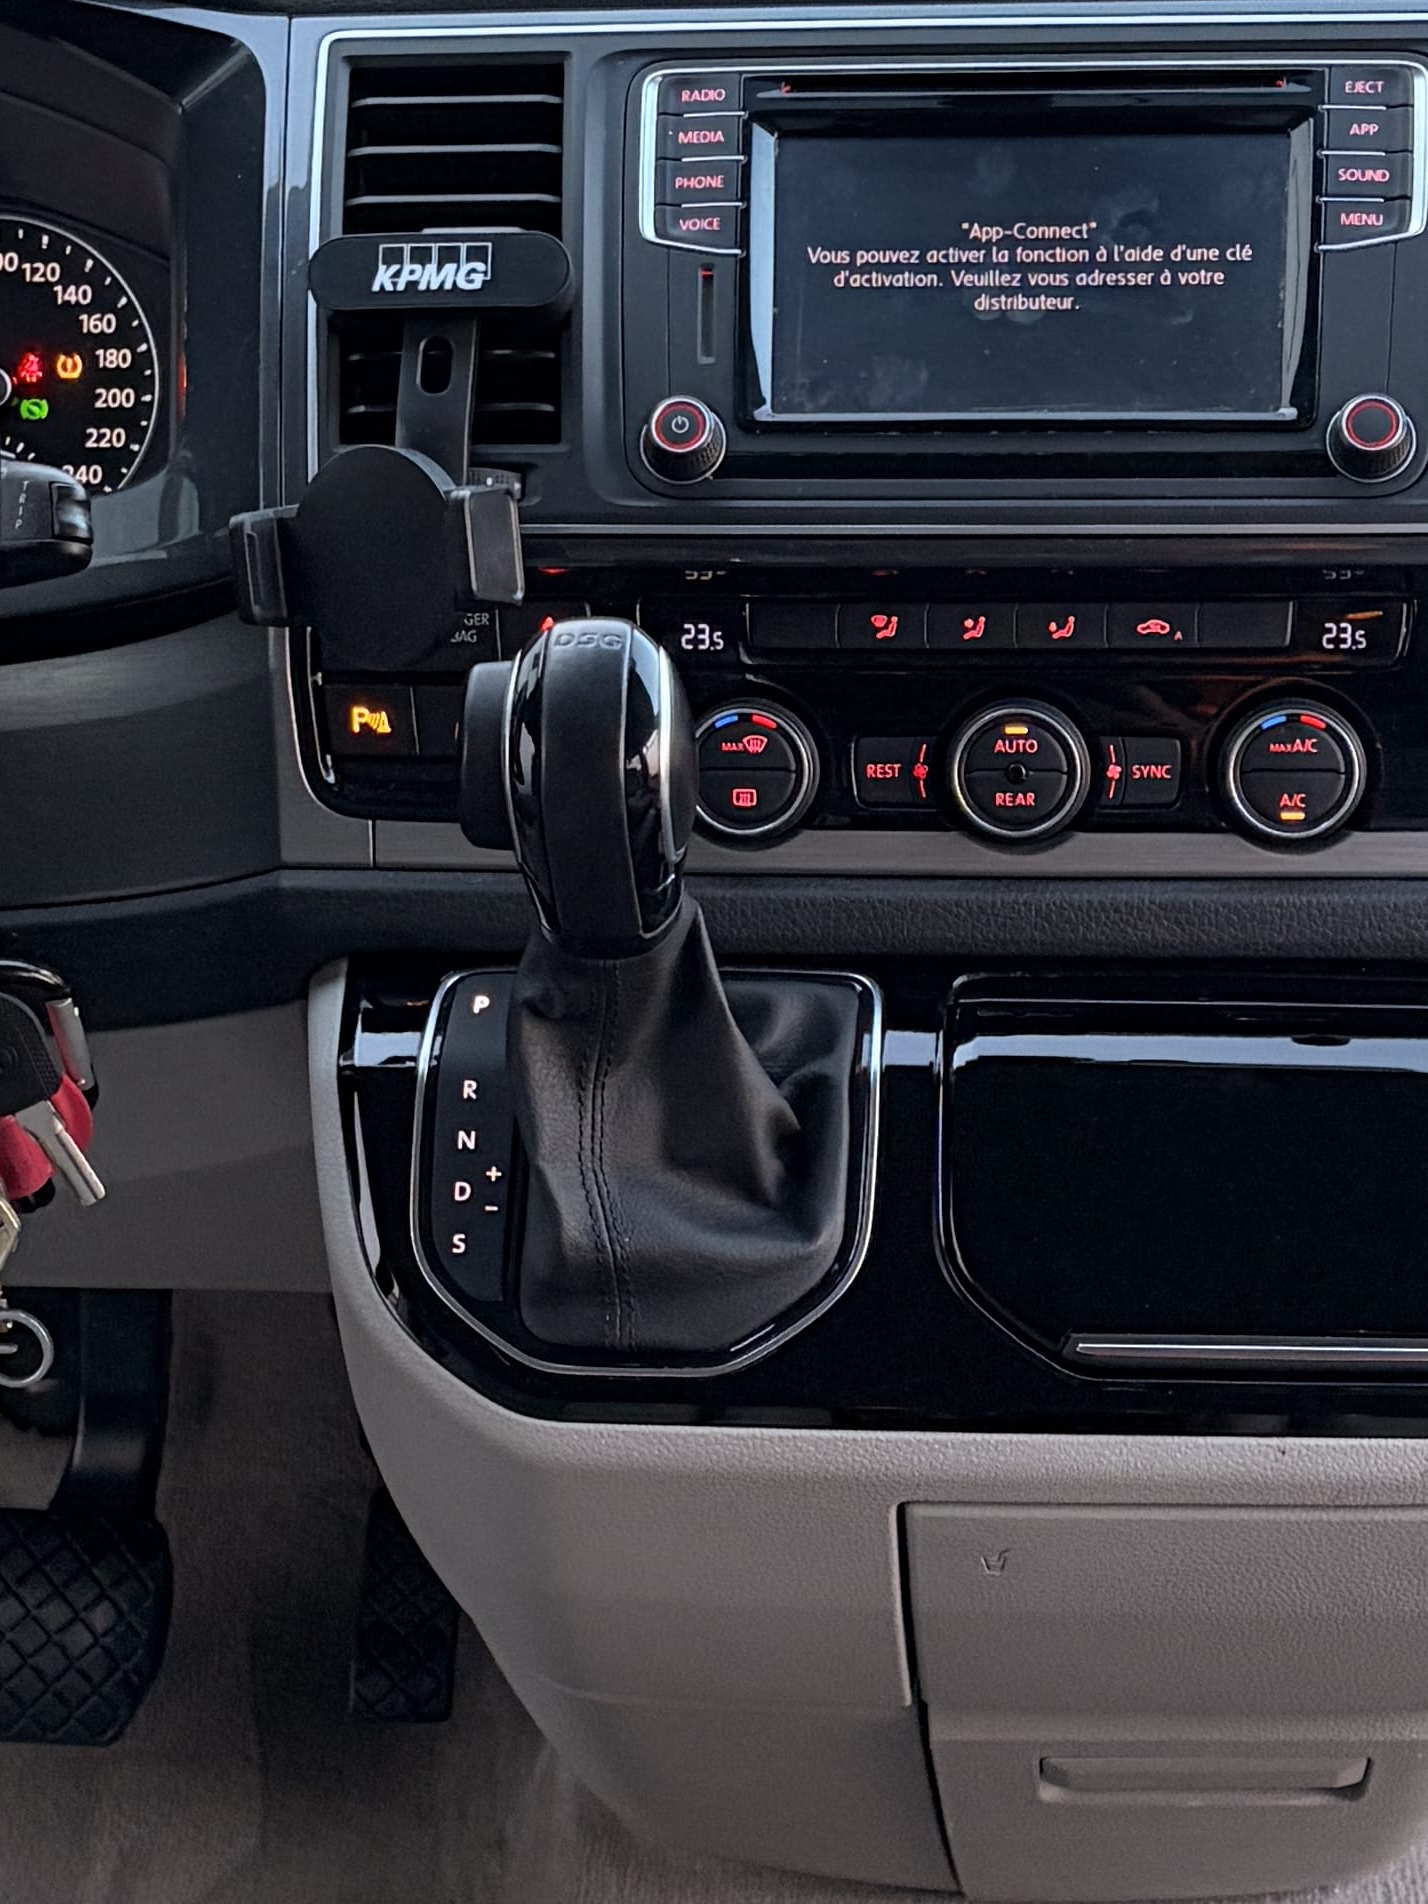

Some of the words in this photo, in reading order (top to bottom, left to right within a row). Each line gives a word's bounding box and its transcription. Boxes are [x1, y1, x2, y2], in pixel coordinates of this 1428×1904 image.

[681, 89, 726, 102] RADIO
[1344, 81, 1385, 94] EJECT
[678, 130, 725, 144] MEDIA
[1349, 123, 1379, 136] APP
[675, 175, 725, 189] PHONE
[1338, 168, 1390, 182] SOUND
[679, 217, 721, 230] VOICE
[1340, 213, 1384, 226] MENU
[961, 222, 1098, 242] "App-Connect"
[807, 246, 850, 264] Vous
[856, 249, 920, 266] pouvez
[926, 247, 986, 263] activer
[992, 246, 1009, 263] la
[1016, 246, 1089, 262] fonction
[1095, 246, 1107, 262] à
[1113, 245, 1163, 262] l'aide
[1170, 244, 1219, 262] d'une
[1225, 244, 1253, 261] clé
[21, 262, 61, 283] 120
[372, 261, 487, 292] KPMG
[833, 270, 943, 288] d'activation.
[951, 269, 1021, 286] Veuillez
[1028, 273, 1069, 286] vous
[1076, 269, 1155, 286] adresser
[1160, 269, 1172, 285] à
[1178, 270, 1225, 285] votre
[53, 284, 92, 305] 140
[974, 294, 1080, 311] distributeur.
[78, 313, 117, 334] 160
[94, 348, 133, 369] 180
[94, 387, 135, 408] 200
[84, 427, 126, 448] 220
[15, 480, 29, 529] TRIP
[554, 632, 622, 649] DSG
[681, 623, 724, 651] 23.5
[1322, 622, 1367, 650] 23.5
[994, 739, 1038, 753] AUTO
[866, 763, 902, 778] REST
[1131, 764, 1172, 779] SYNC
[995, 792, 1035, 806] REAR
[1279, 793, 1306, 807] A/C
[472, 996, 490, 1014] P
[462, 1079, 478, 1100] R
[457, 1130, 475, 1149] N
[454, 1181, 471, 1201] D
[452, 1233, 467, 1254] S
